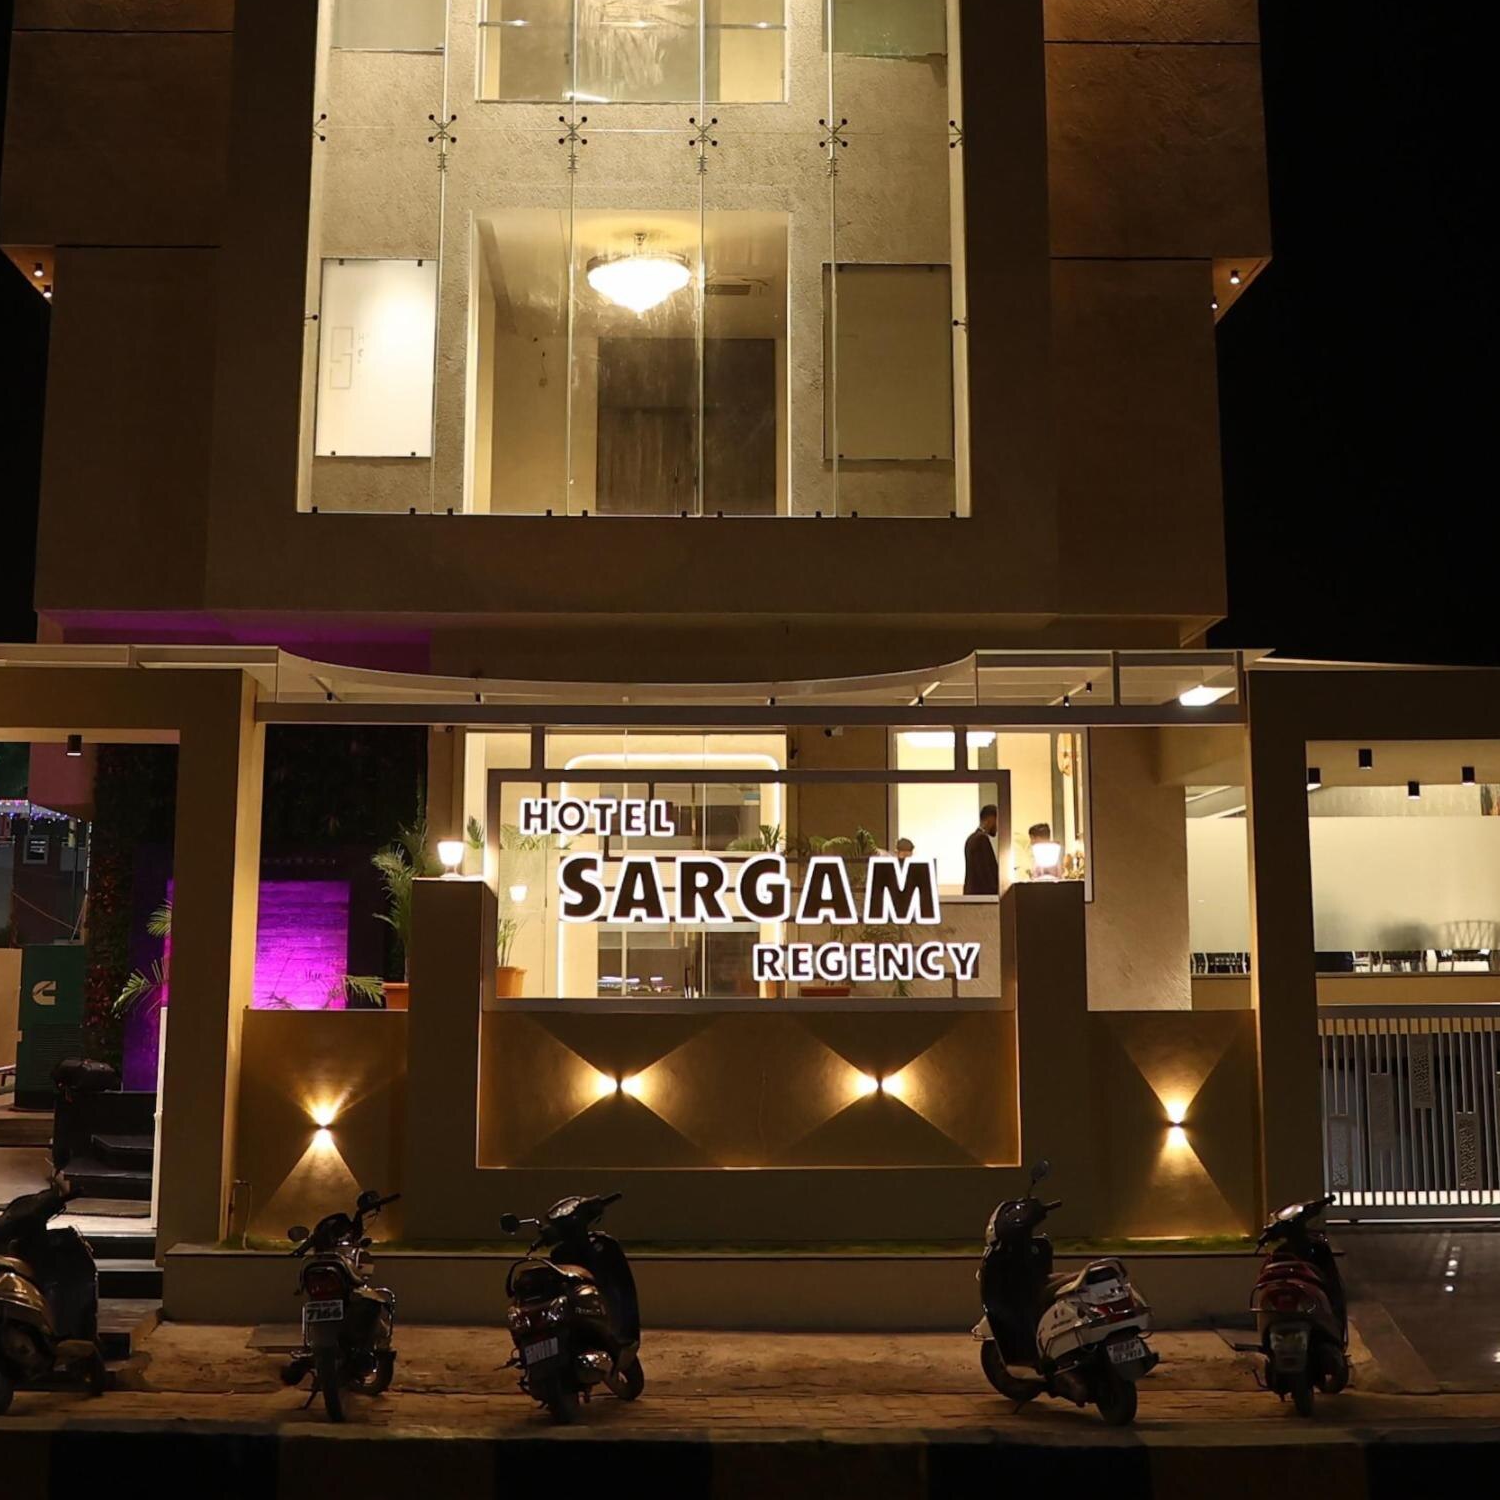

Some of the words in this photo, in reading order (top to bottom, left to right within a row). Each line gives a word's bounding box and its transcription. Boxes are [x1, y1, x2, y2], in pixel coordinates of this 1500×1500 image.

[520, 798, 675, 837] HOTEL
[557, 852, 941, 925] SARGAM
[753, 942, 981, 981] REGENCY
